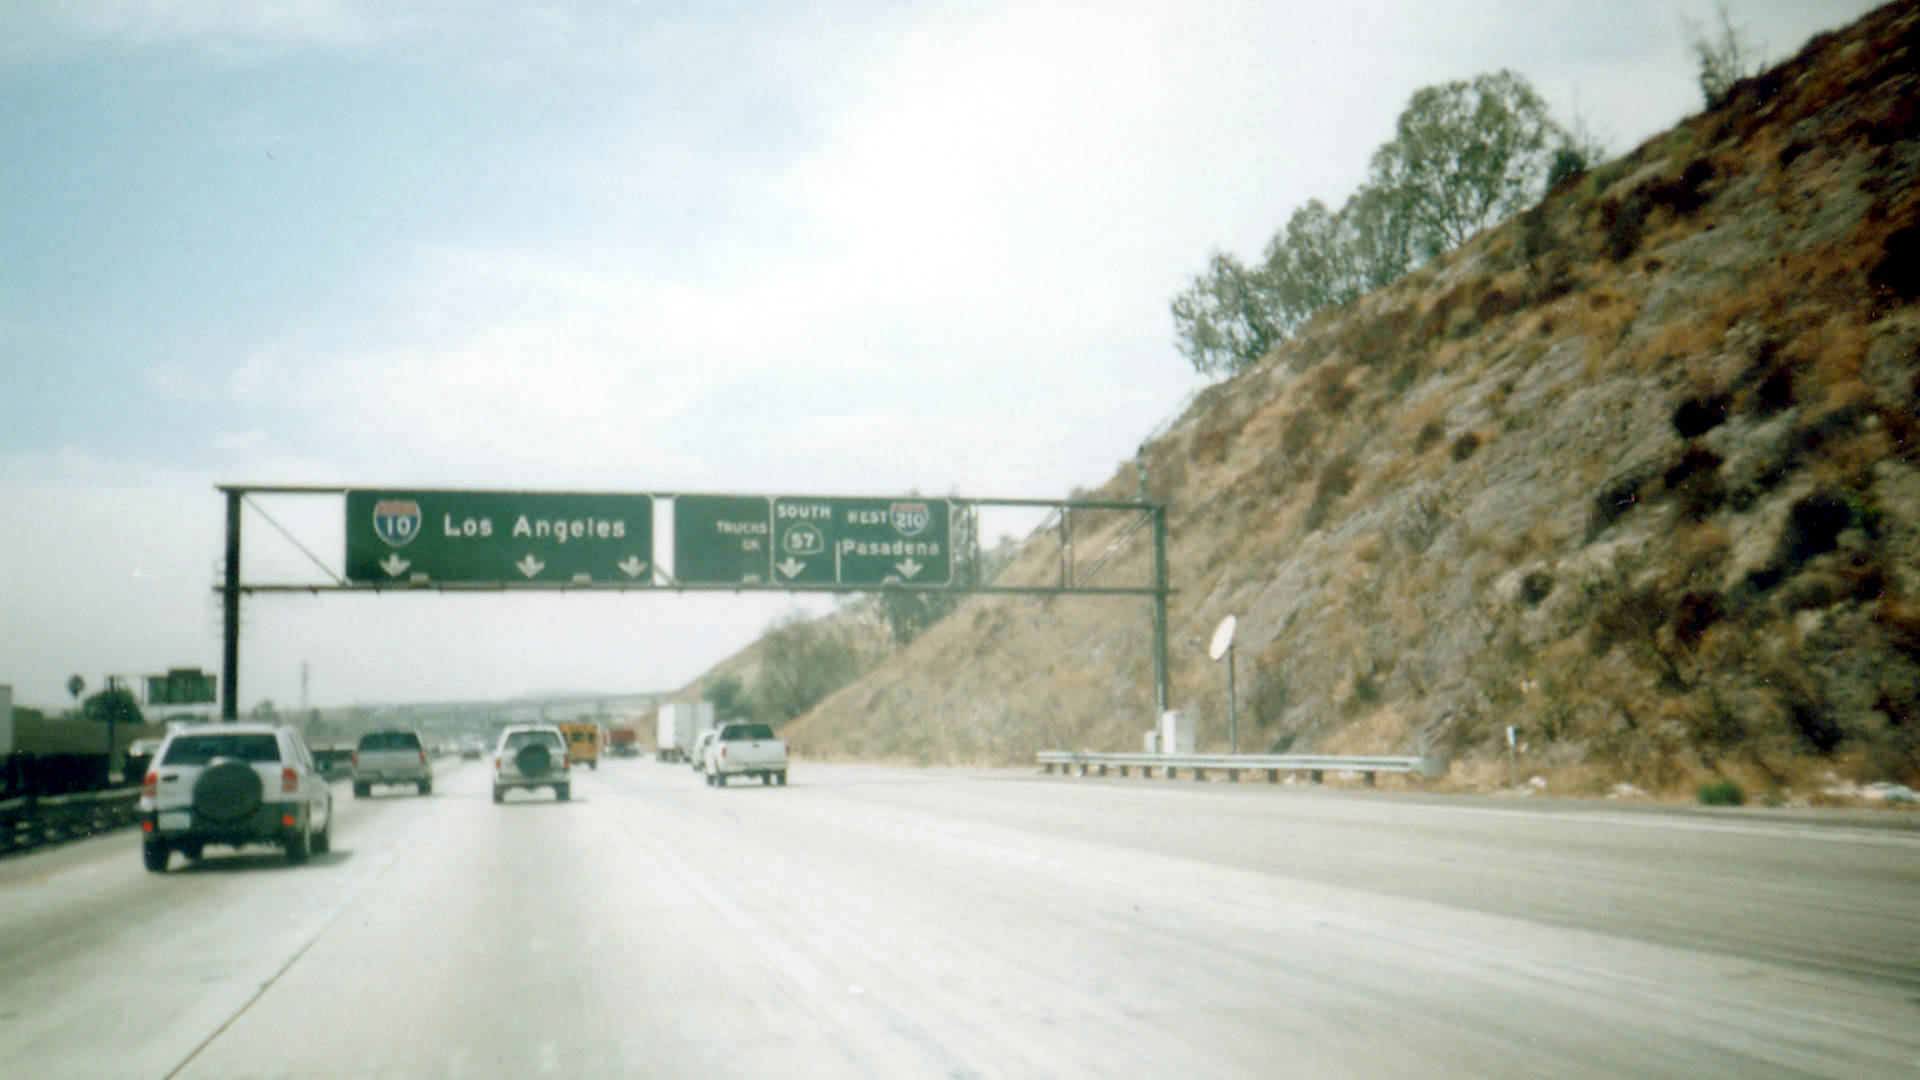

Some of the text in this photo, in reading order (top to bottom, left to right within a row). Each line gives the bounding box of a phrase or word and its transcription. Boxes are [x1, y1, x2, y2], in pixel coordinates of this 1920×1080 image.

[776, 505, 831, 519] SOUTH
[847, 511, 925, 529] WEST 210
[386, 517, 411, 535] 10
[443, 513, 626, 543] Los Angeles
[716, 521, 767, 535] TRUCKS
[791, 532, 815, 549] 57
[842, 539, 940, 556] Pasadena
